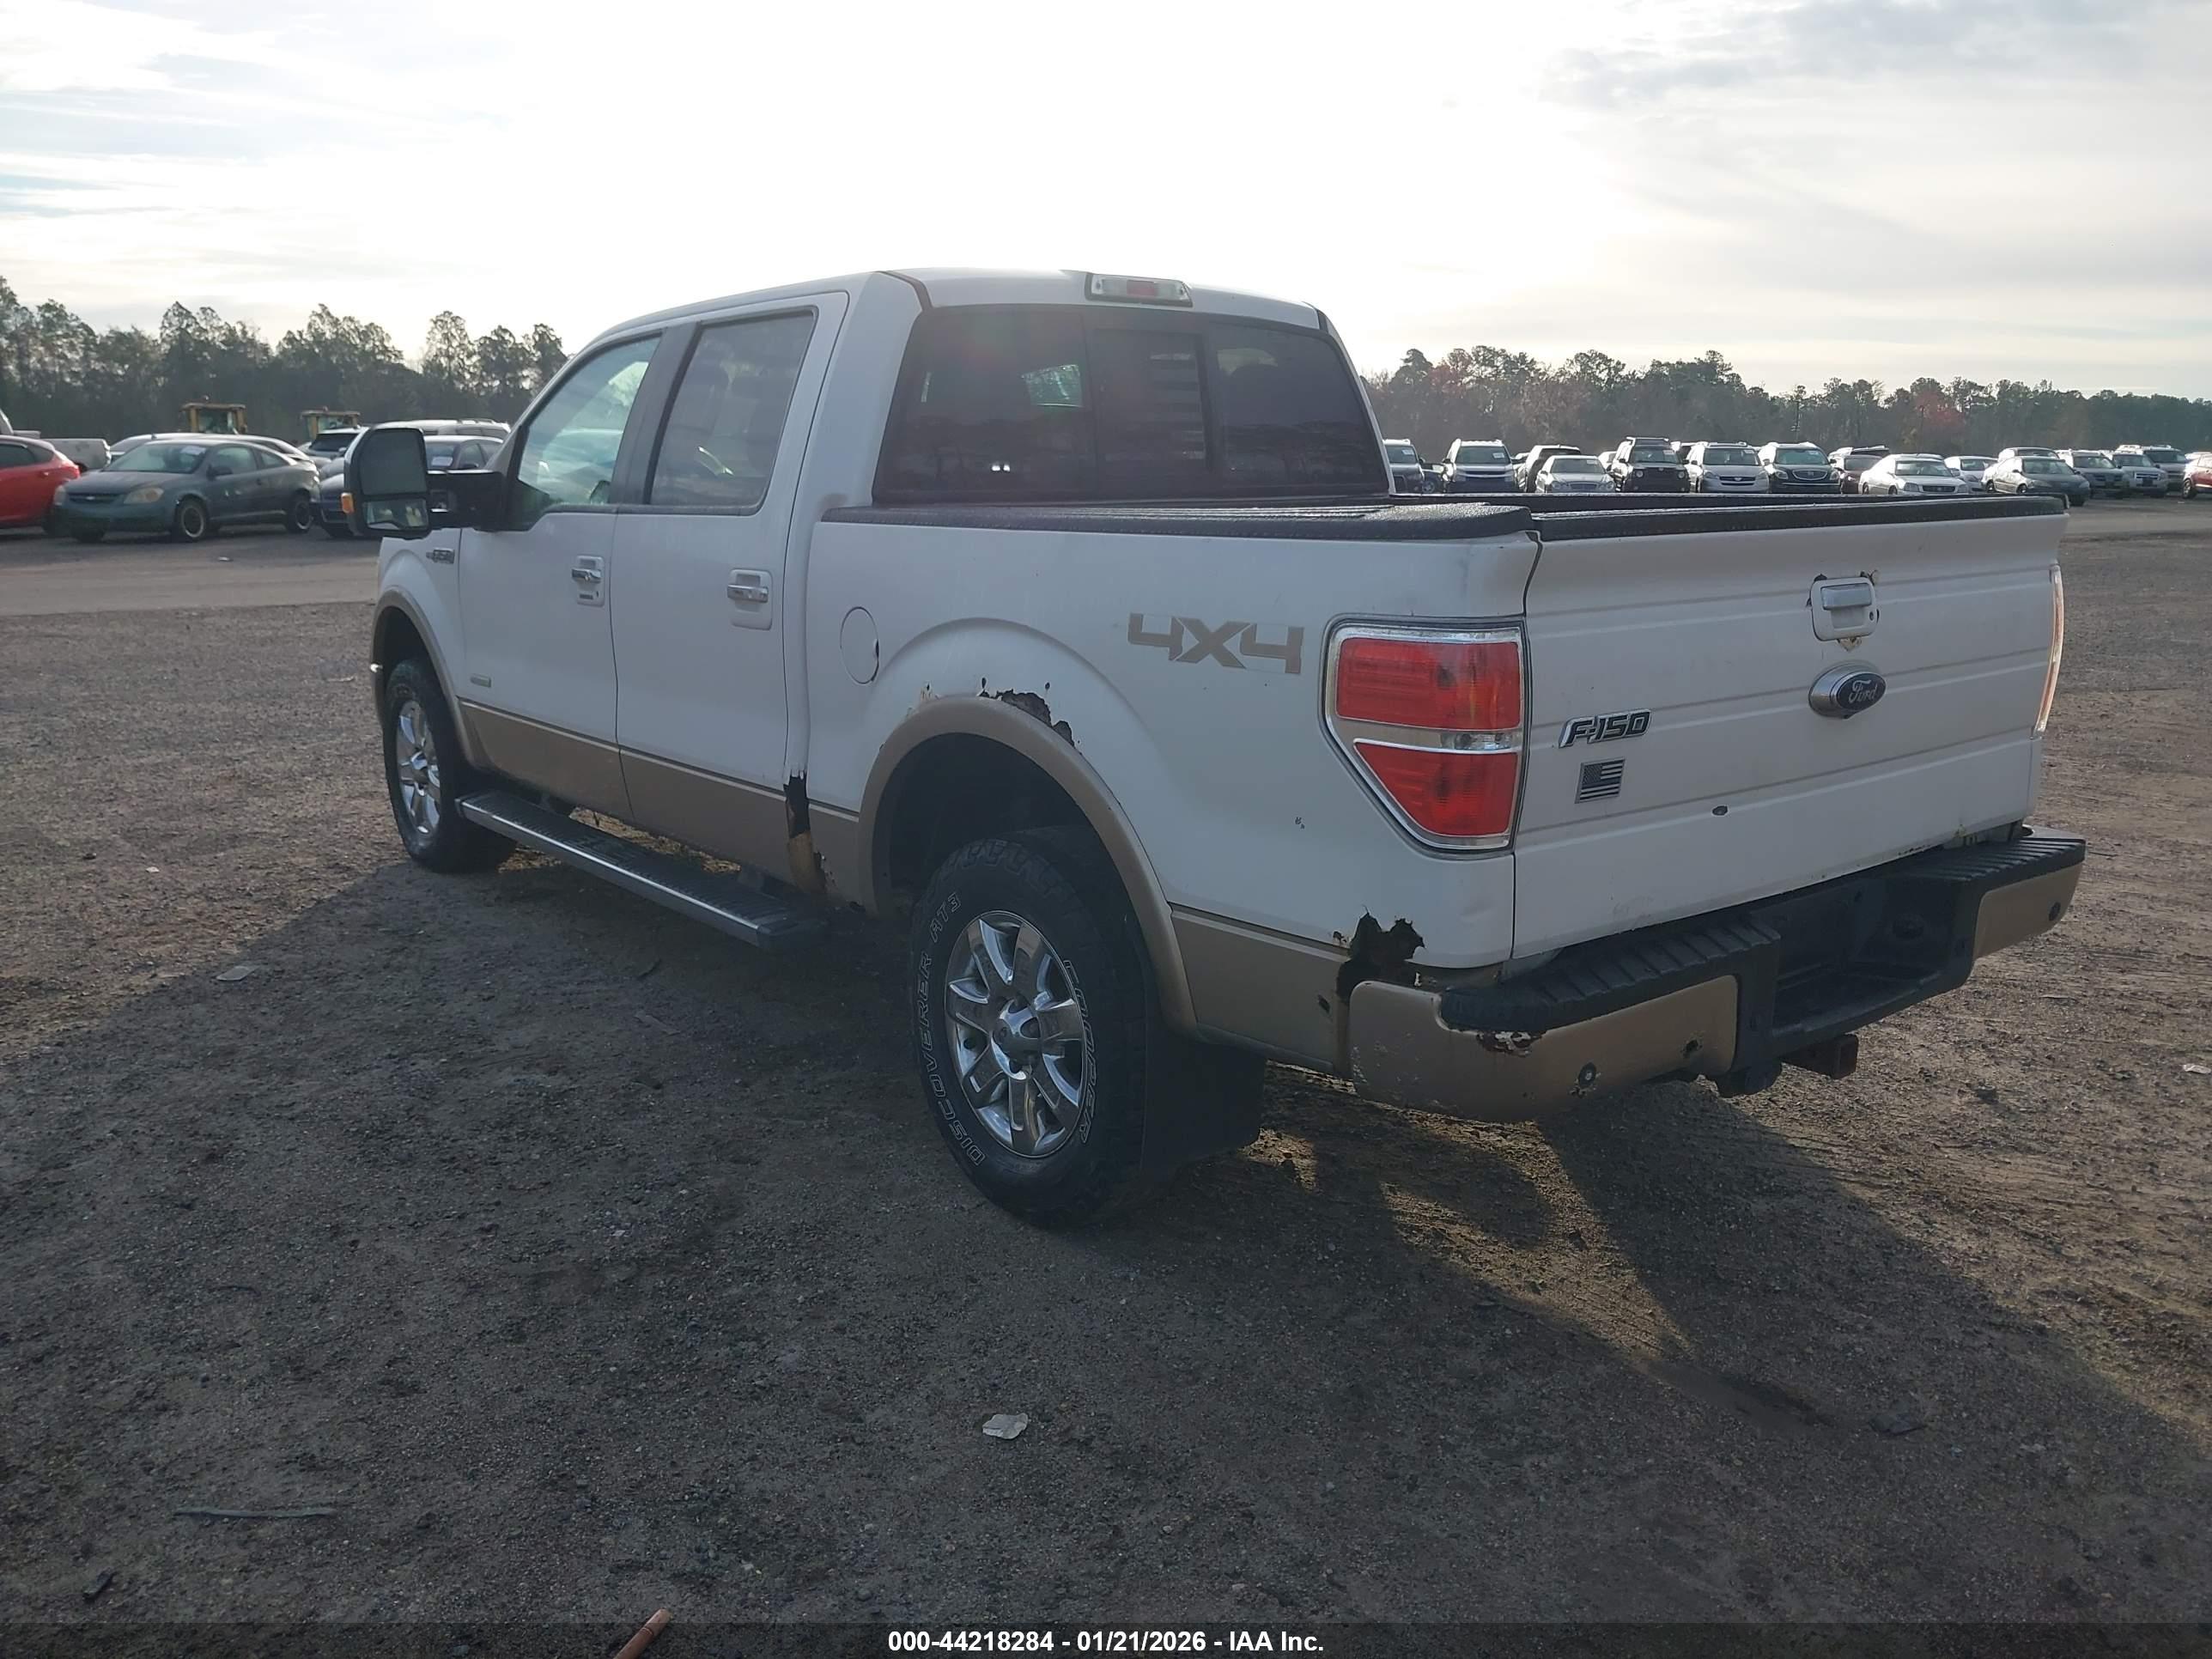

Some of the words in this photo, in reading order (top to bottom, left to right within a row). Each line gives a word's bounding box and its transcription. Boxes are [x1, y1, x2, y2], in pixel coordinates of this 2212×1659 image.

[1848, 678, 1878, 704] Ford
[1559, 708, 1651, 748] F-150
[929, 893, 961, 943] AT3
[917, 952, 987, 1167] DISCOVERER
